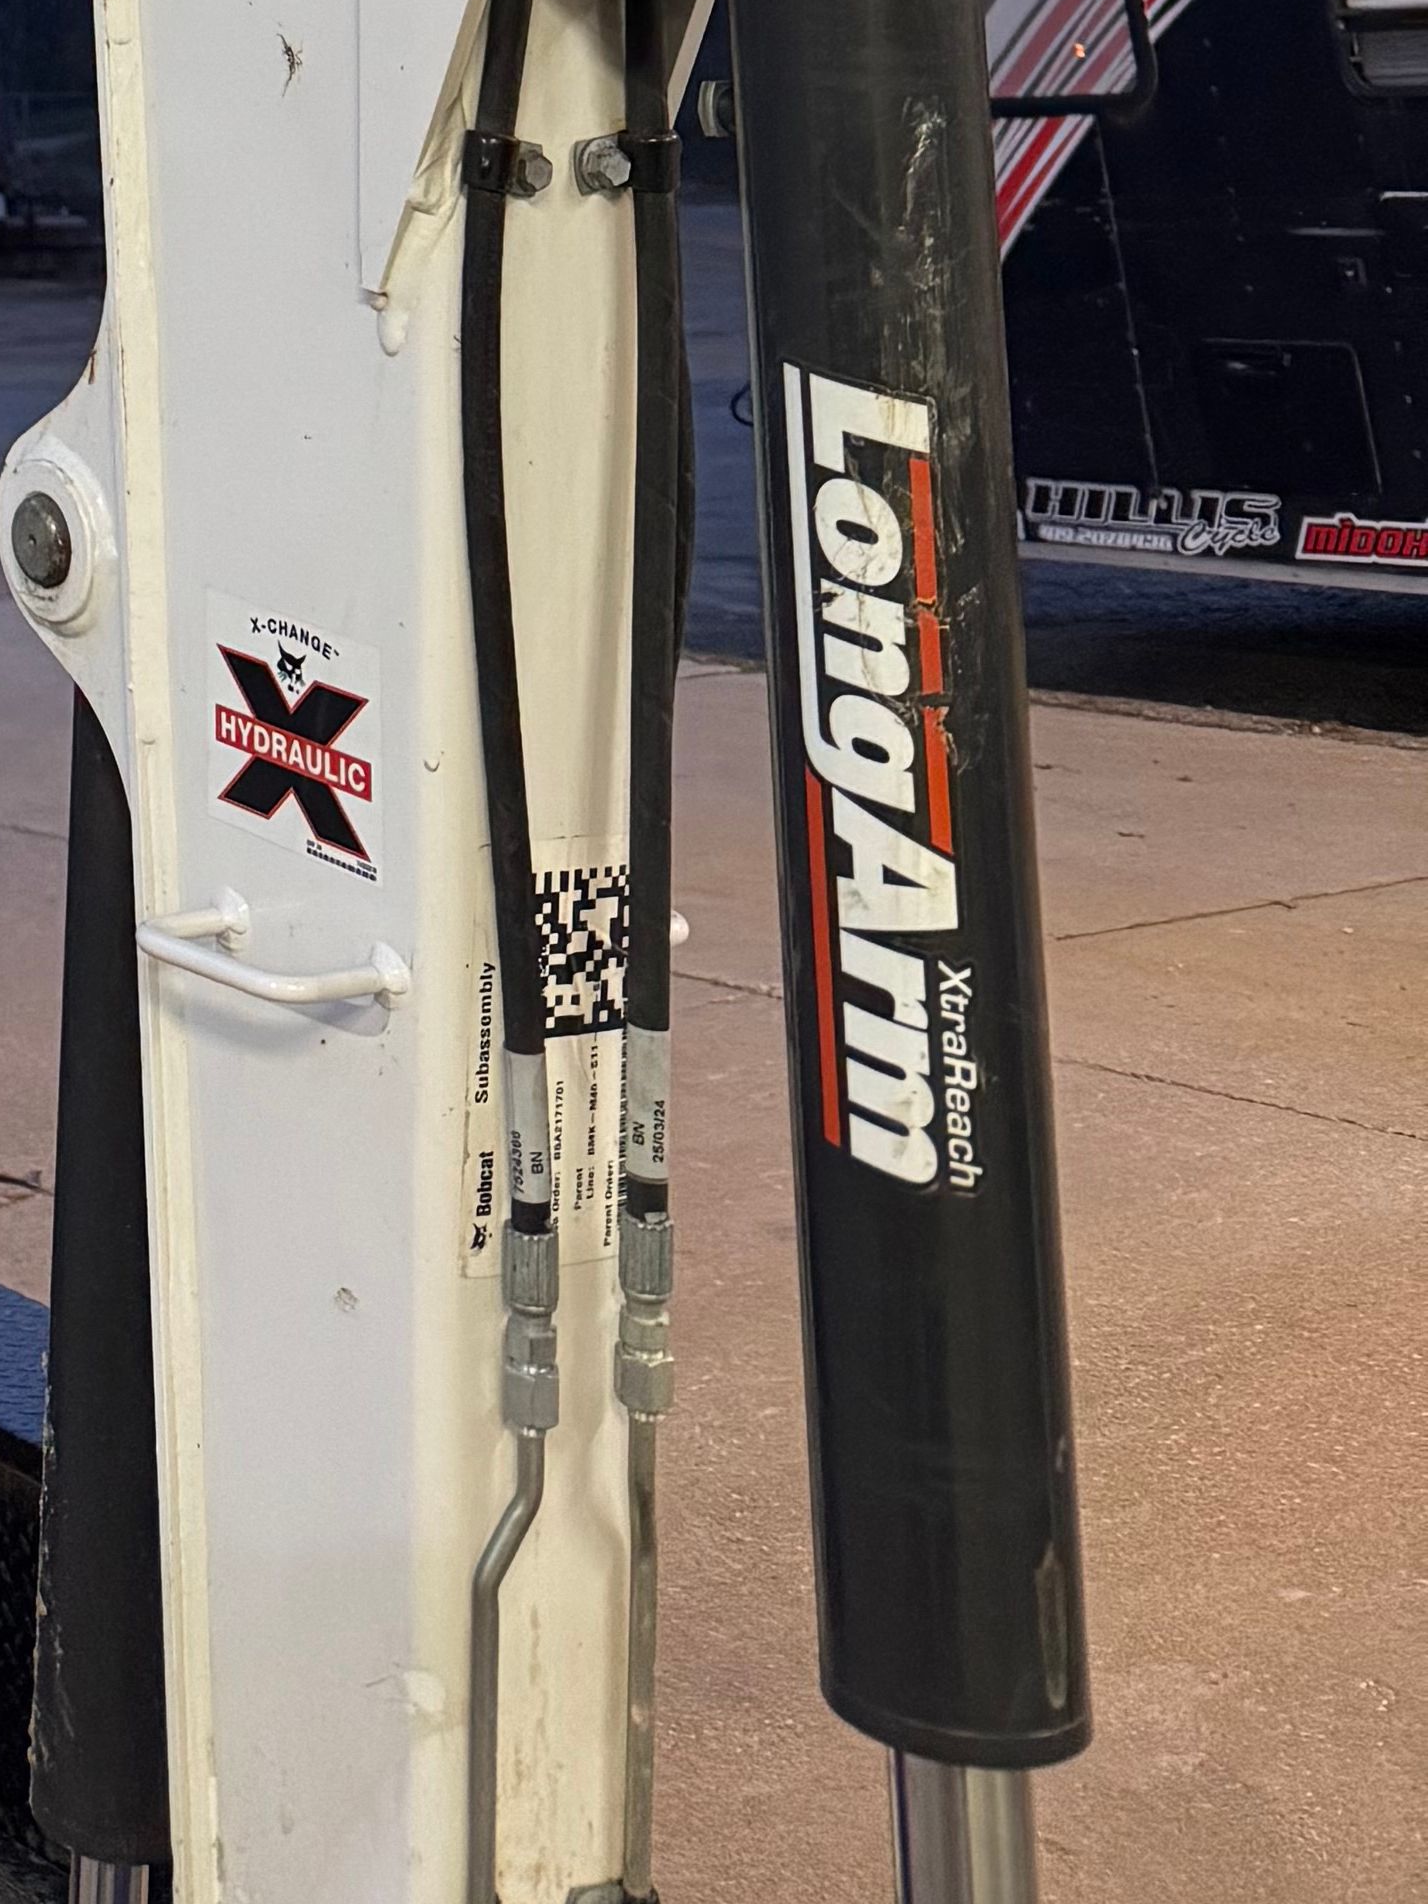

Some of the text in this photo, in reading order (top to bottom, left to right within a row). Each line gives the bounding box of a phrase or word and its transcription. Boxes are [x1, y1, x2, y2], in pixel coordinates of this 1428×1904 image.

[1176, 518, 1281, 556] Cycle
[220, 711, 366, 793] HYDRAULIC
[784, 362, 958, 1184] LongArm
[475, 962, 496, 1218] Bobcat Subassembly
[938, 960, 983, 1188] XtraReach
[530, 1151, 544, 1175] BN
[632, 1121, 646, 1146] BN
[652, 1099, 666, 1163] 25/03/24
